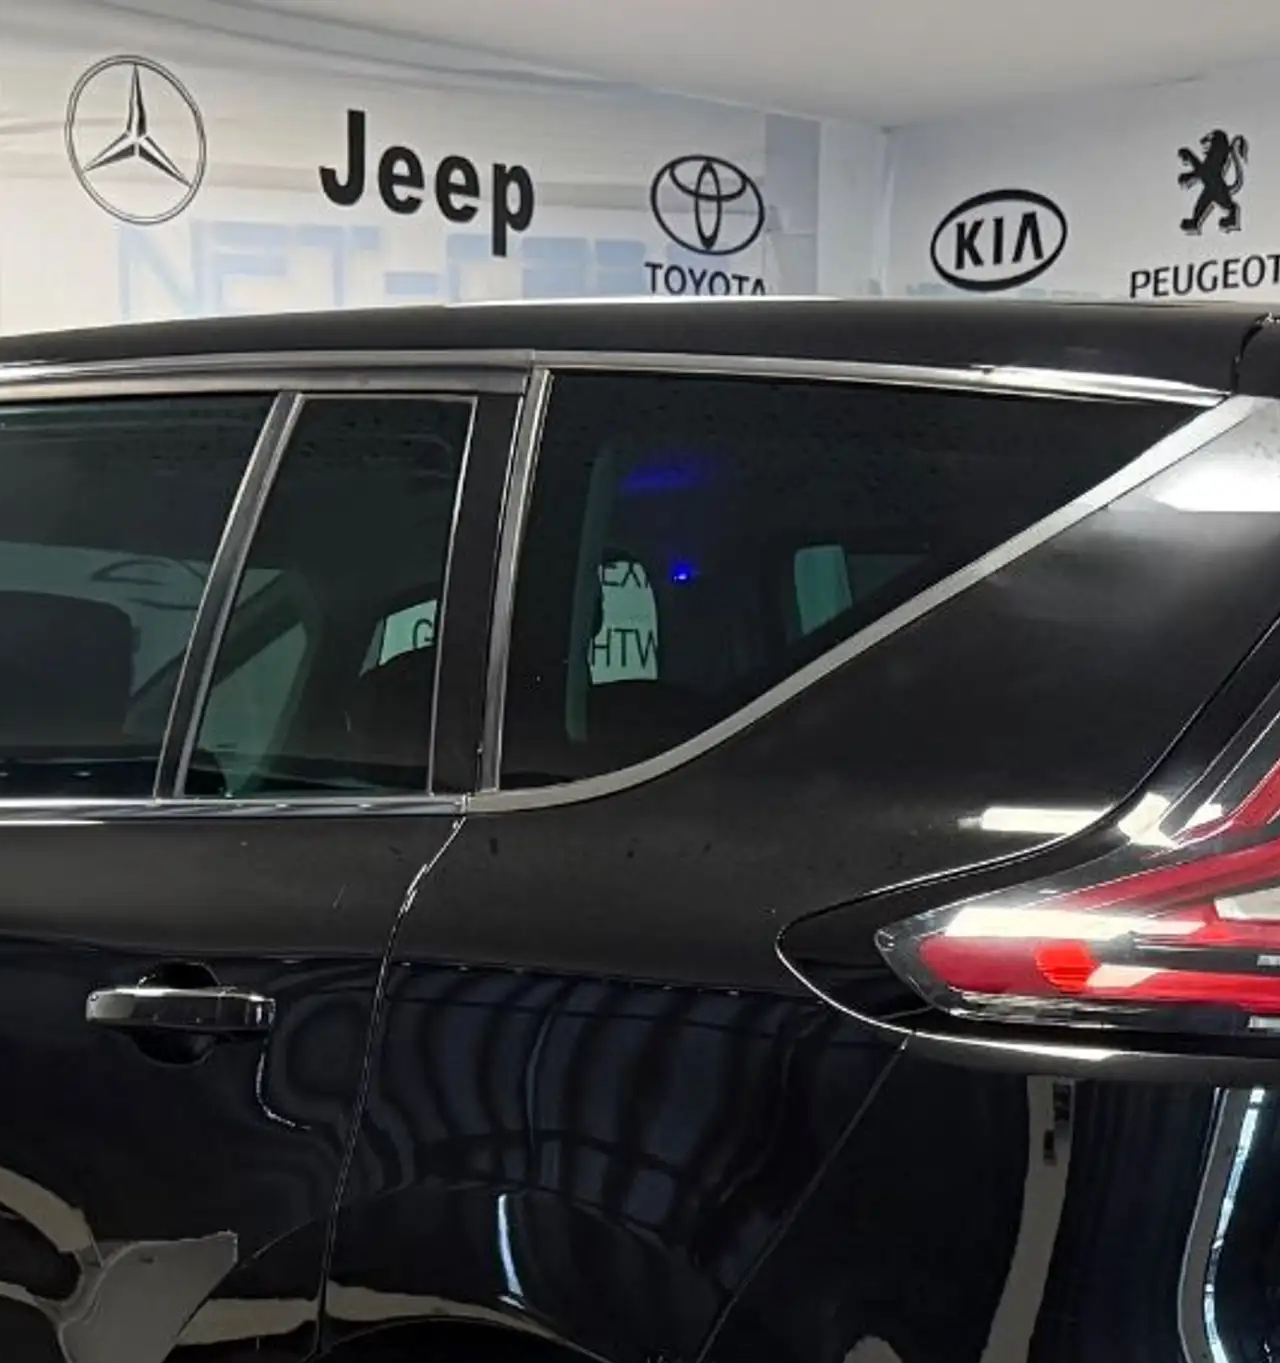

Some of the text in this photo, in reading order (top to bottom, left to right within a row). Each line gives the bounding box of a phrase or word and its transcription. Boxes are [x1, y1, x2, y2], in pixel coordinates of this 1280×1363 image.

[319, 109, 536, 257] Jeep
[953, 210, 1045, 271] KIA
[644, 261, 767, 297] TOYOTA
